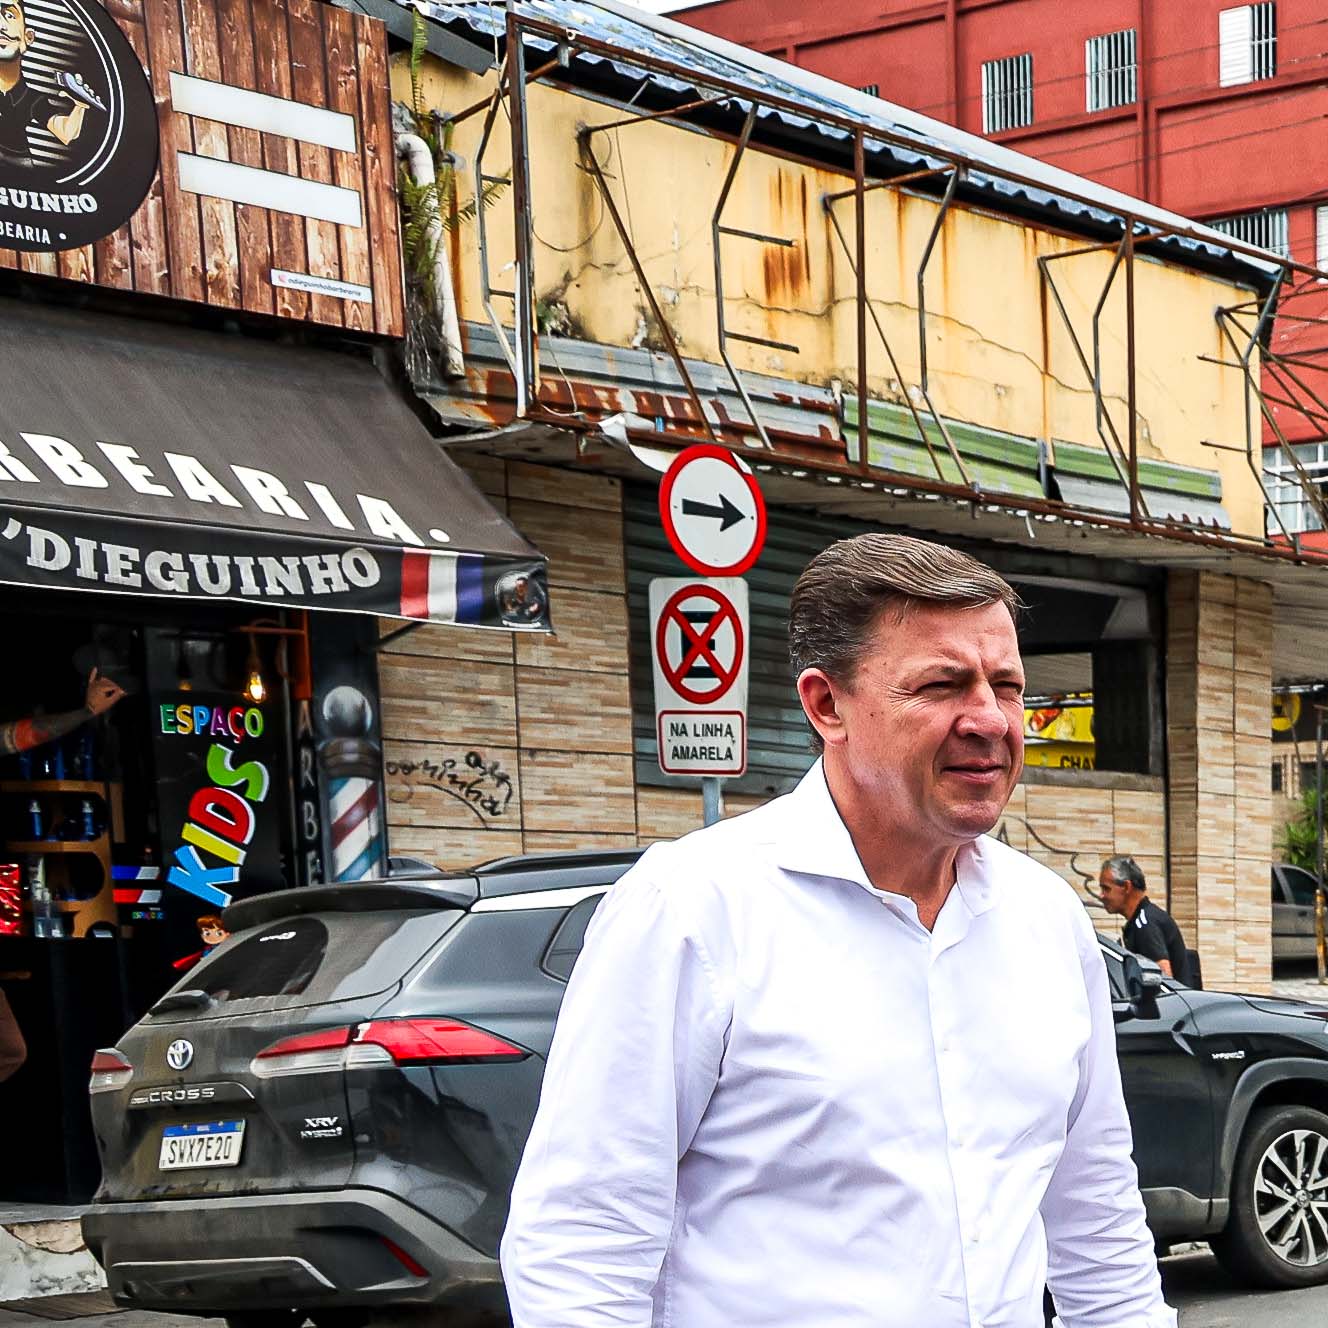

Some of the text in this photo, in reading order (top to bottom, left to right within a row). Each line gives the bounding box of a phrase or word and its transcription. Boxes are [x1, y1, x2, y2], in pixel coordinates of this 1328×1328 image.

[159, 704, 264, 744] ESPAÇO
[670, 722, 734, 738] NA LINHA
[671, 745, 734, 760] AMARELA
[166, 743, 270, 908] KIDS
[149, 1087, 215, 1103] CROSS
